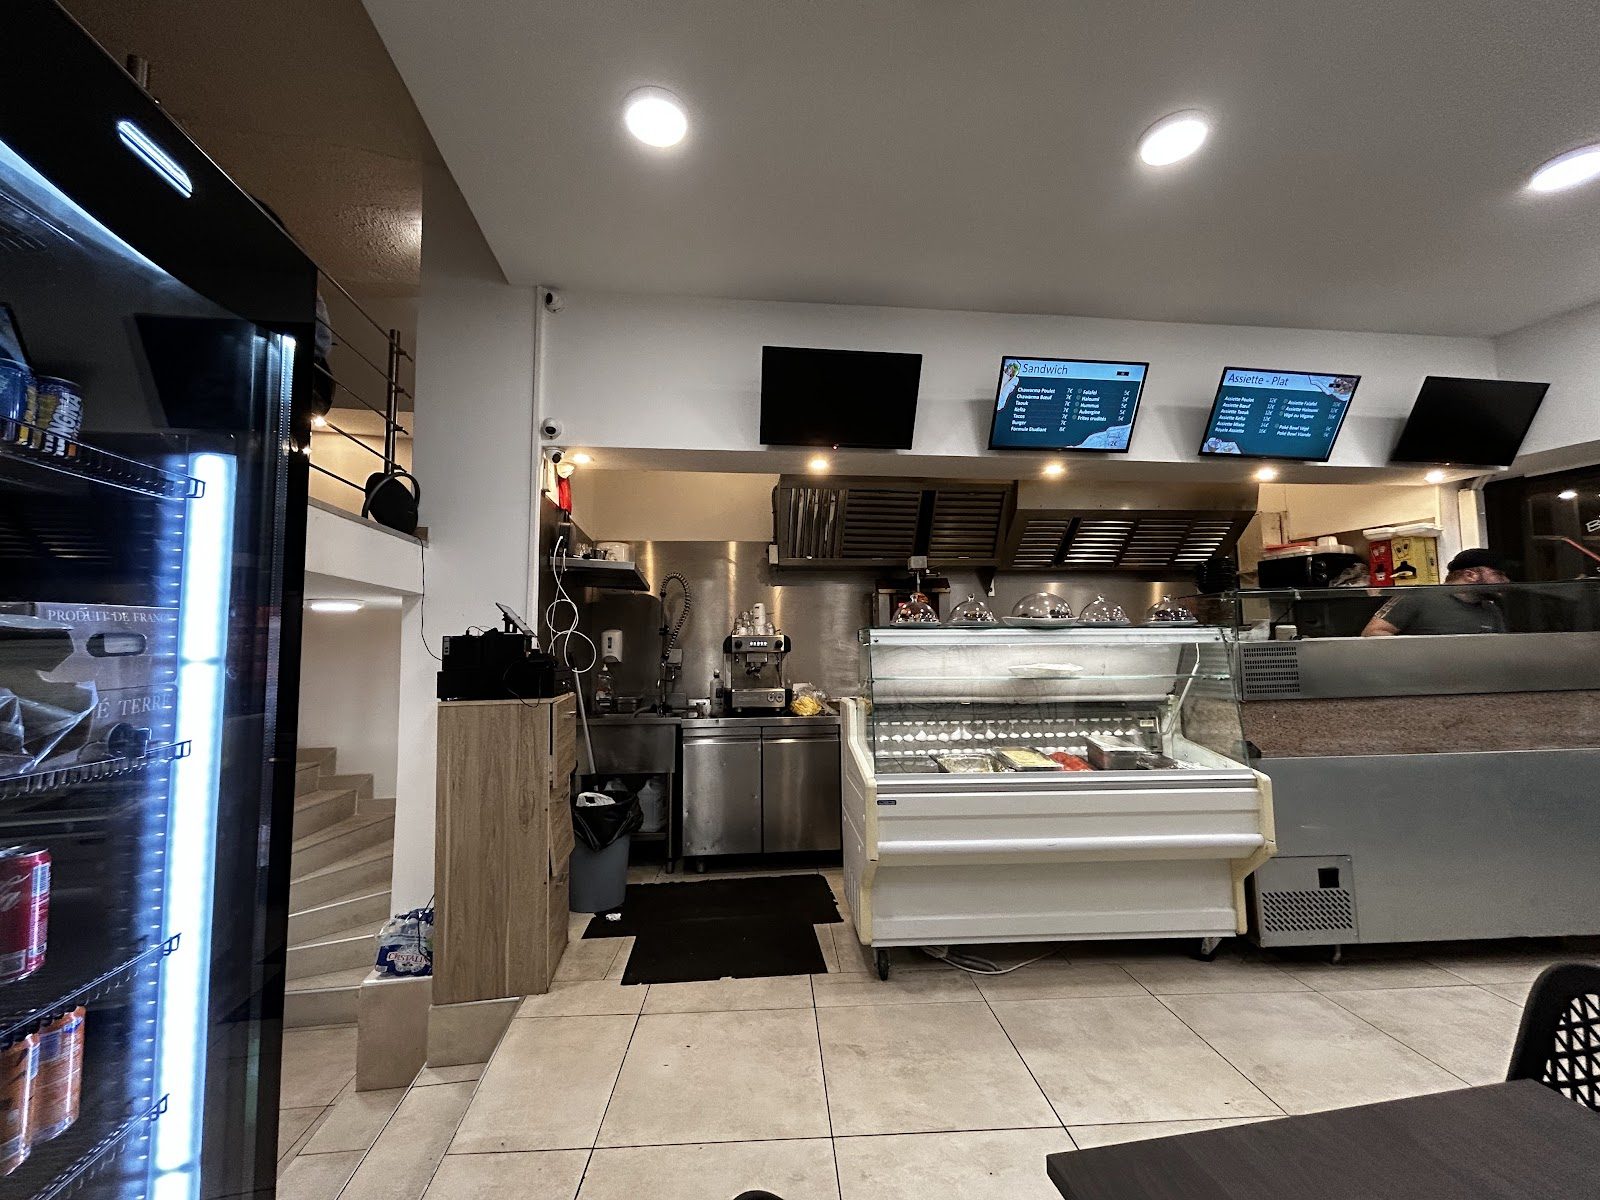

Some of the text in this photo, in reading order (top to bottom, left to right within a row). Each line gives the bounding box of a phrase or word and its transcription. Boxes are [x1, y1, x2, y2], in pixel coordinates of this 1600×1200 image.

[1022, 364, 1068, 375] Sandwich
[1228, 373, 1264, 385] Assiette
[1271, 376, 1289, 386] Plat
[48, 609, 109, 622] PRODUIT
[112, 611, 129, 622] DE
